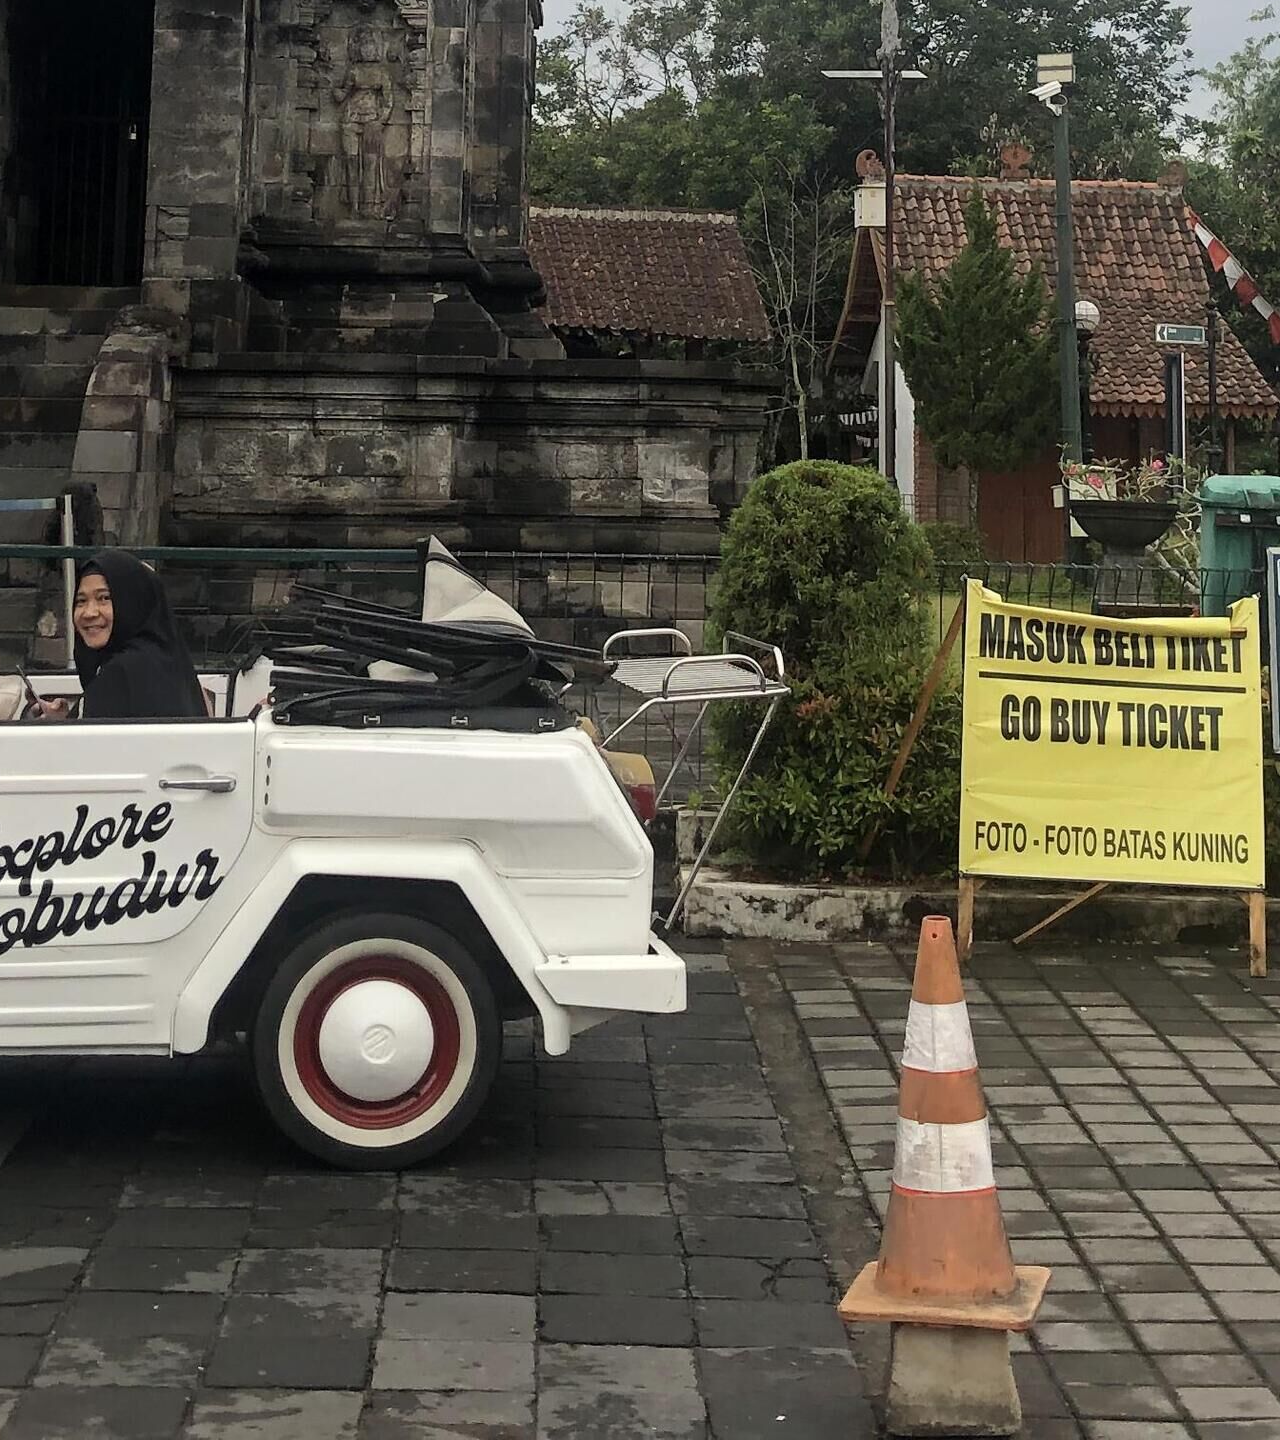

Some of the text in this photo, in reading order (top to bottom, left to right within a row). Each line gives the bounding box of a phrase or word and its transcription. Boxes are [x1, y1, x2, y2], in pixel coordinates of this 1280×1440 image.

[979, 613, 1243, 673] MASUK BELI TIKET
[1001, 694, 1223, 751] GO BUY TICKET
[975, 821, 1027, 853] FOTO
[1045, 825, 1097, 857] FOTO
[1104, 828, 1166, 860] BATAS
[1173, 831, 1249, 864] KUNING
